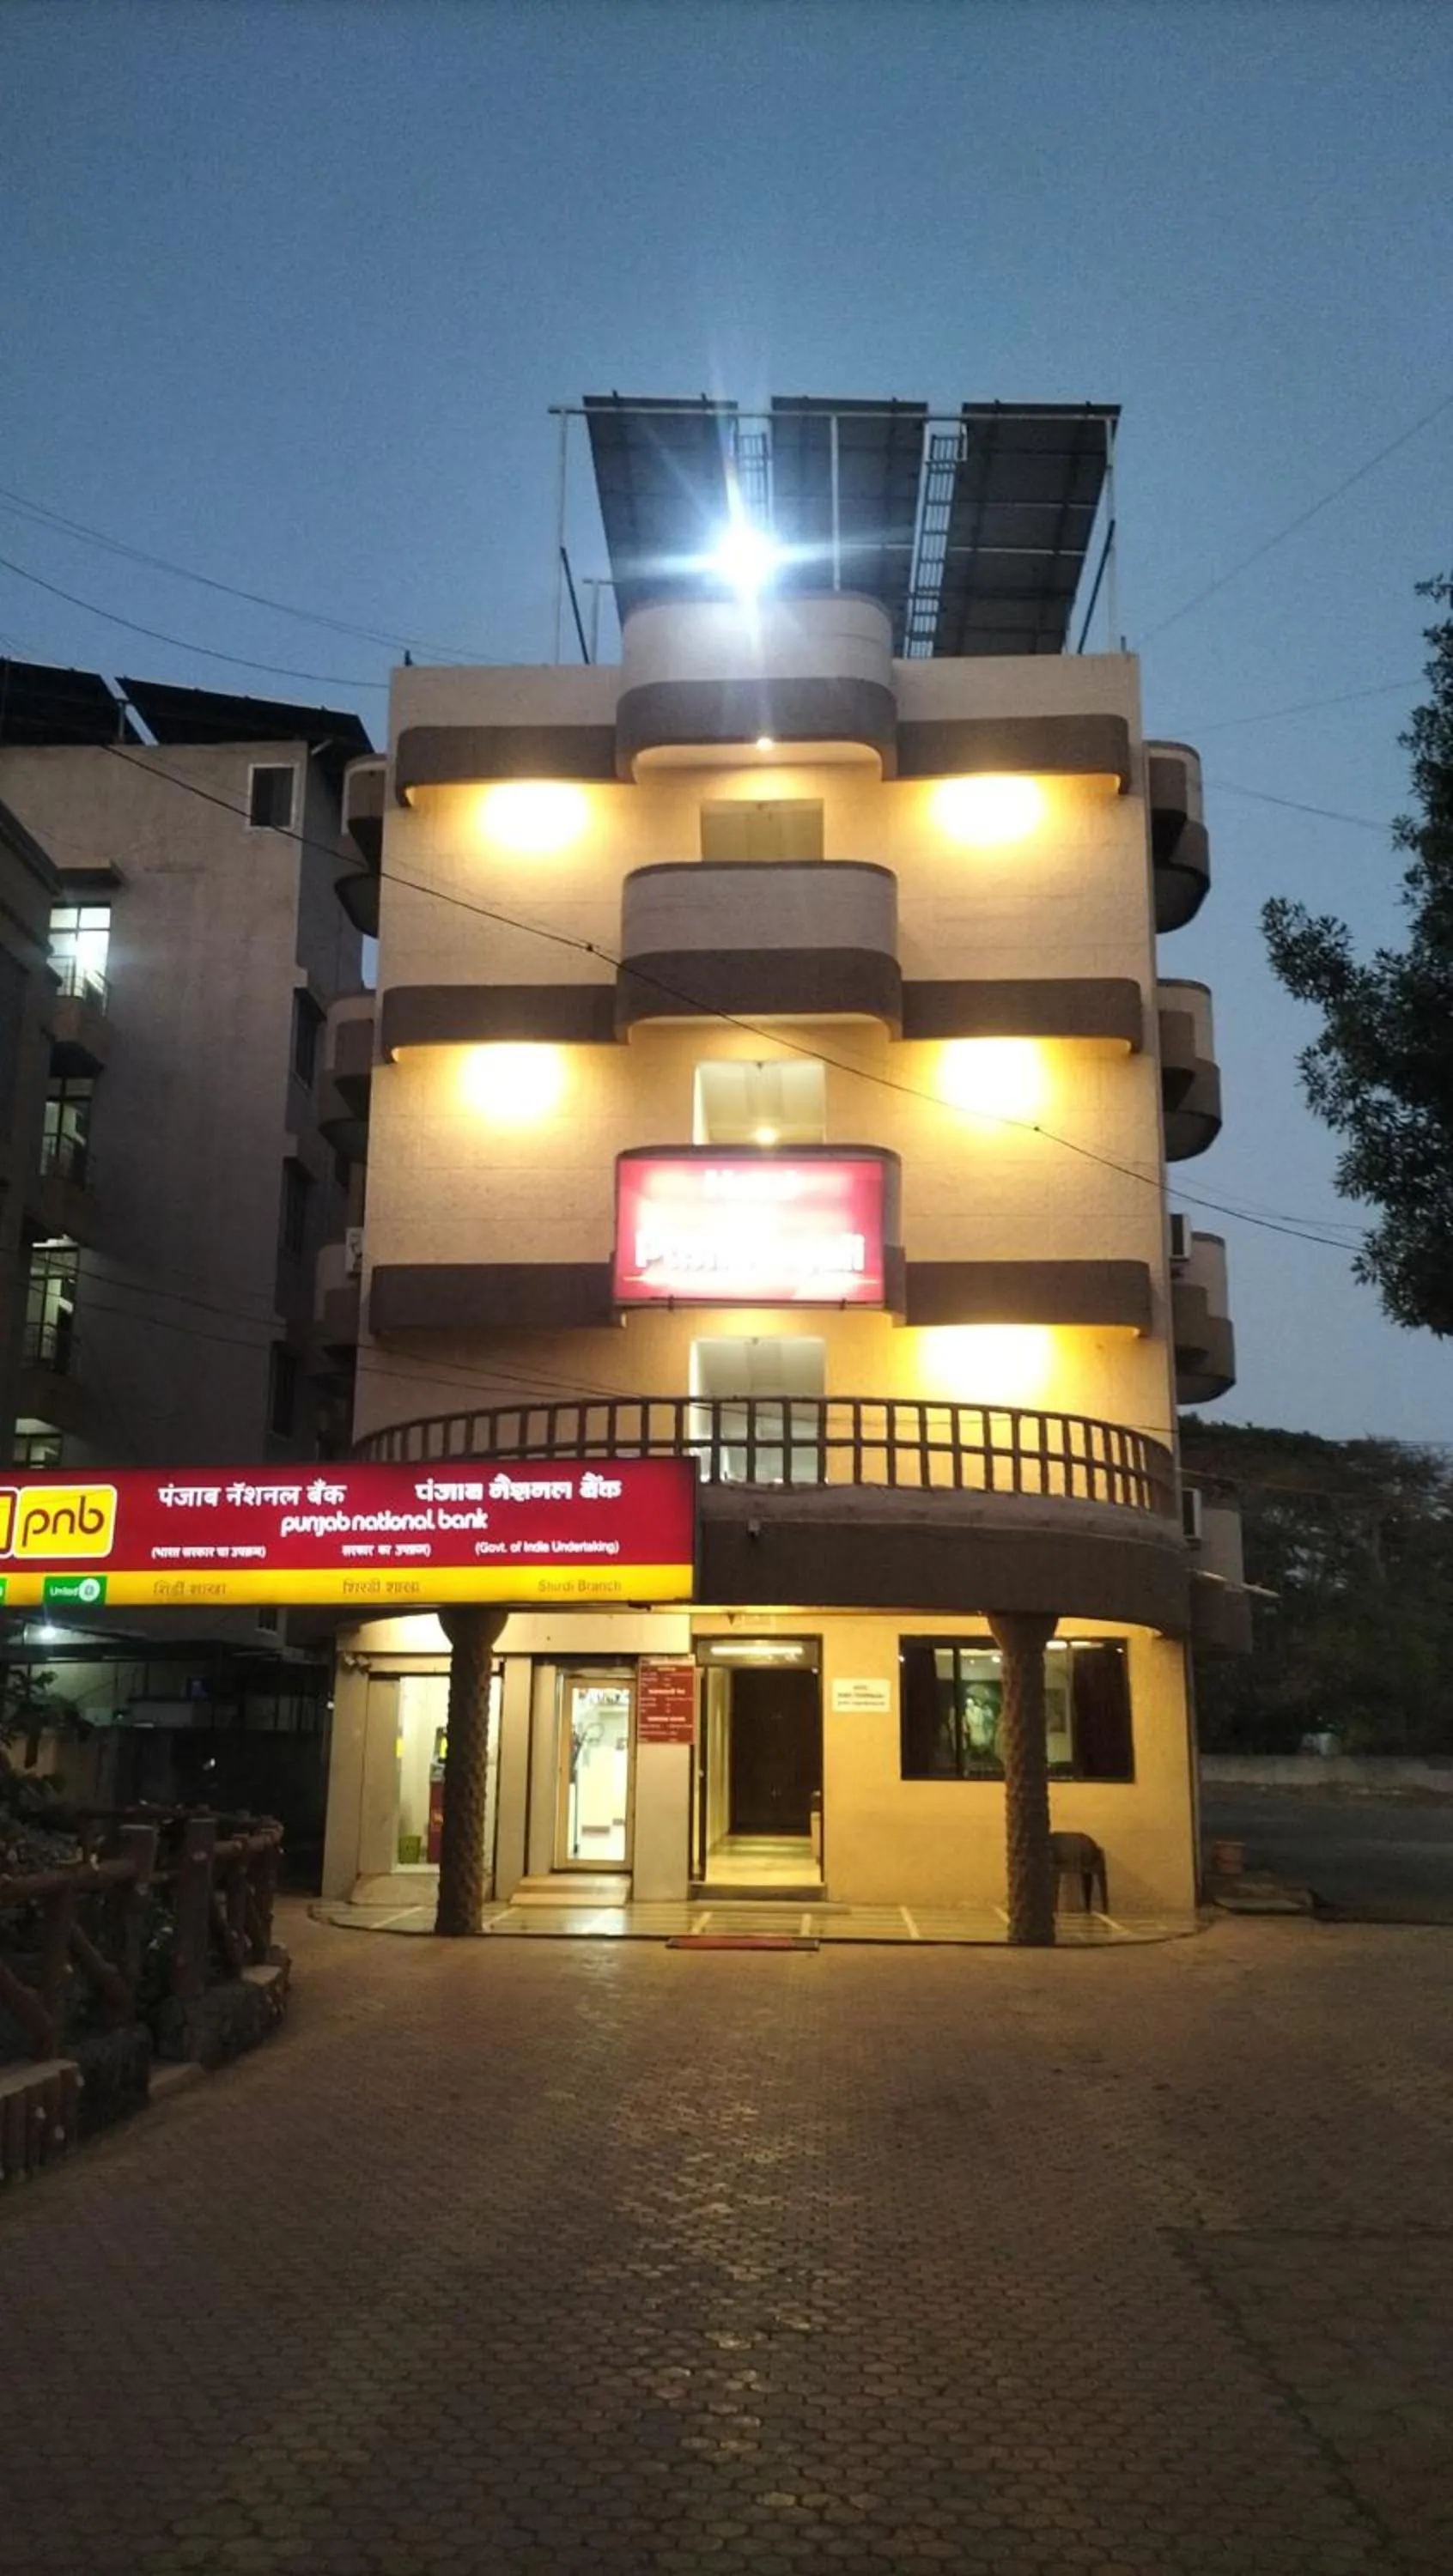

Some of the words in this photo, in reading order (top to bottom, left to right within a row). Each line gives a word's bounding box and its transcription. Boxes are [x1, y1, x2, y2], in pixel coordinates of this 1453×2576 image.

[158, 1483, 222, 1507] पंजाब
[226, 1481, 301, 1506] नॅशनल
[415, 1478, 483, 1501] पंजाब
[21, 1495, 105, 1548] pnb
[280, 1510, 350, 1537] punjab
[351, 1510, 435, 1531] national
[437, 1508, 489, 1530] bank
[523, 1539, 550, 1553] India
[551, 1539, 620, 1555] Undertaking)
[537, 1578, 575, 1592] Shirdi
[577, 1578, 622, 1593] Branch
